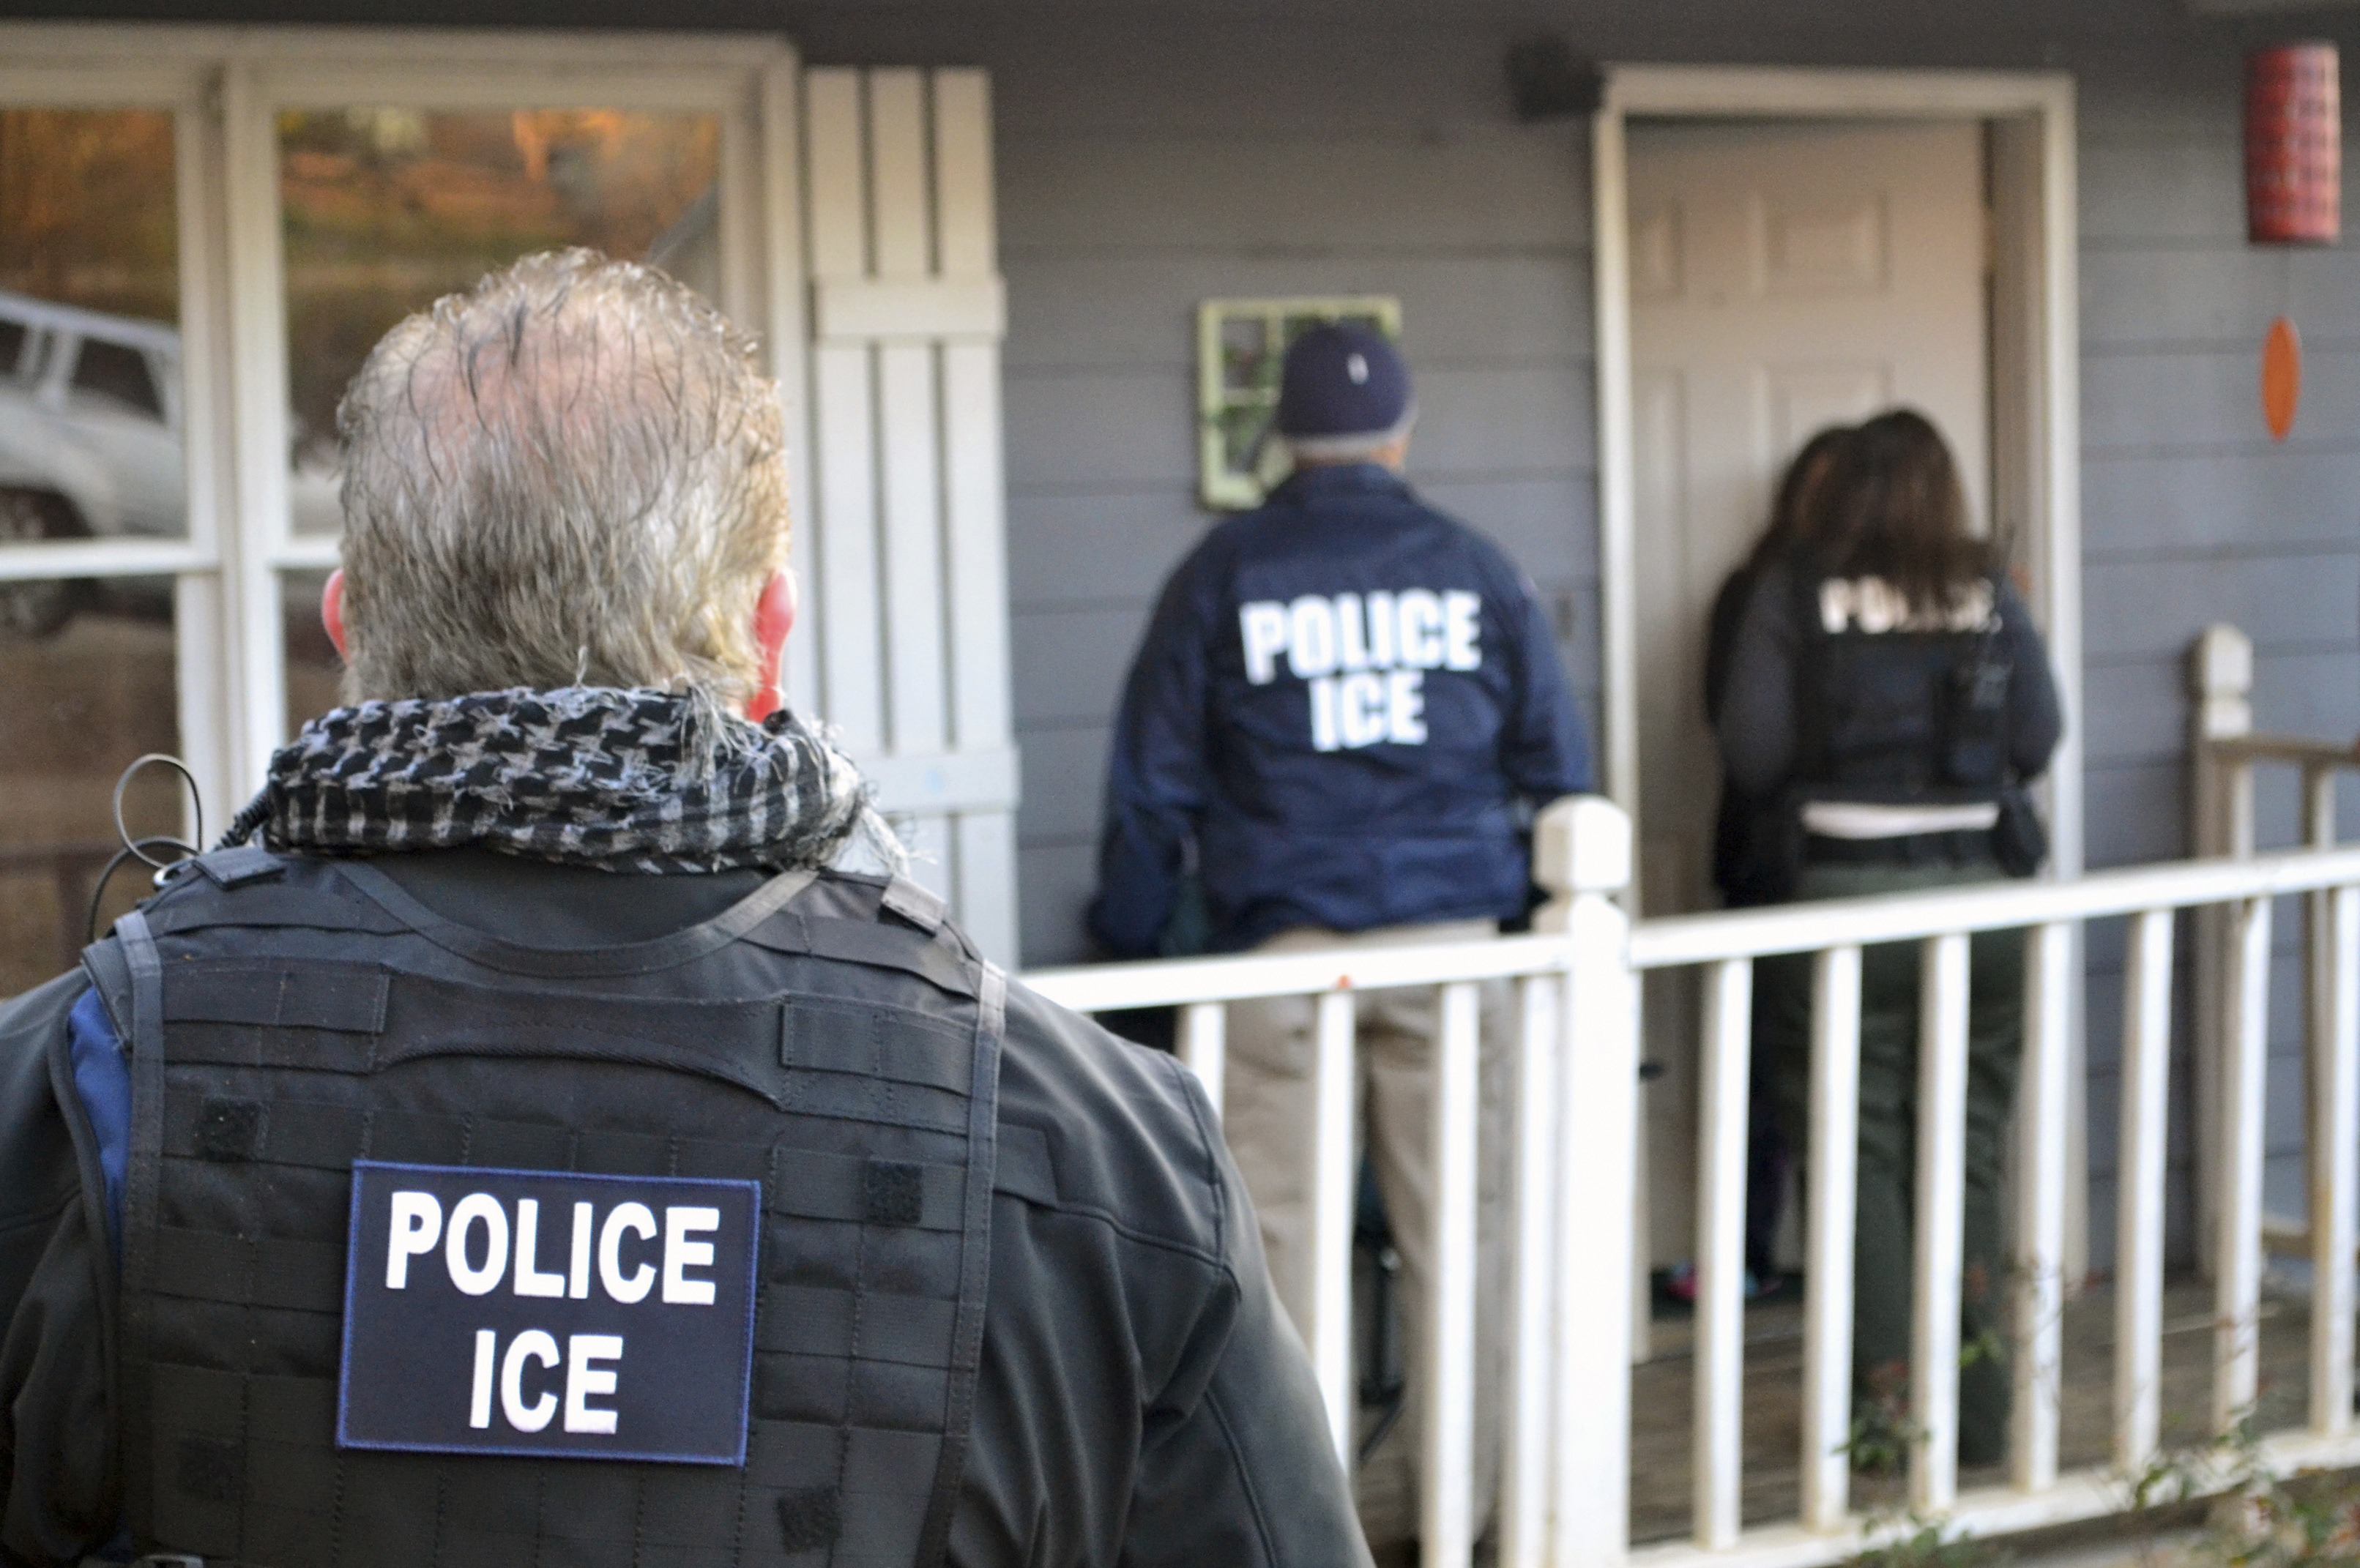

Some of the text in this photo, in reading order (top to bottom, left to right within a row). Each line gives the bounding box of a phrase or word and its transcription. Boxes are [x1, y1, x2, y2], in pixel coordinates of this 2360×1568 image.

[1240, 589, 1482, 685] POLICE
[1309, 669, 1428, 752] ICE
[386, 1190, 720, 1306] POLICE
[469, 1329, 623, 1435] ICE
